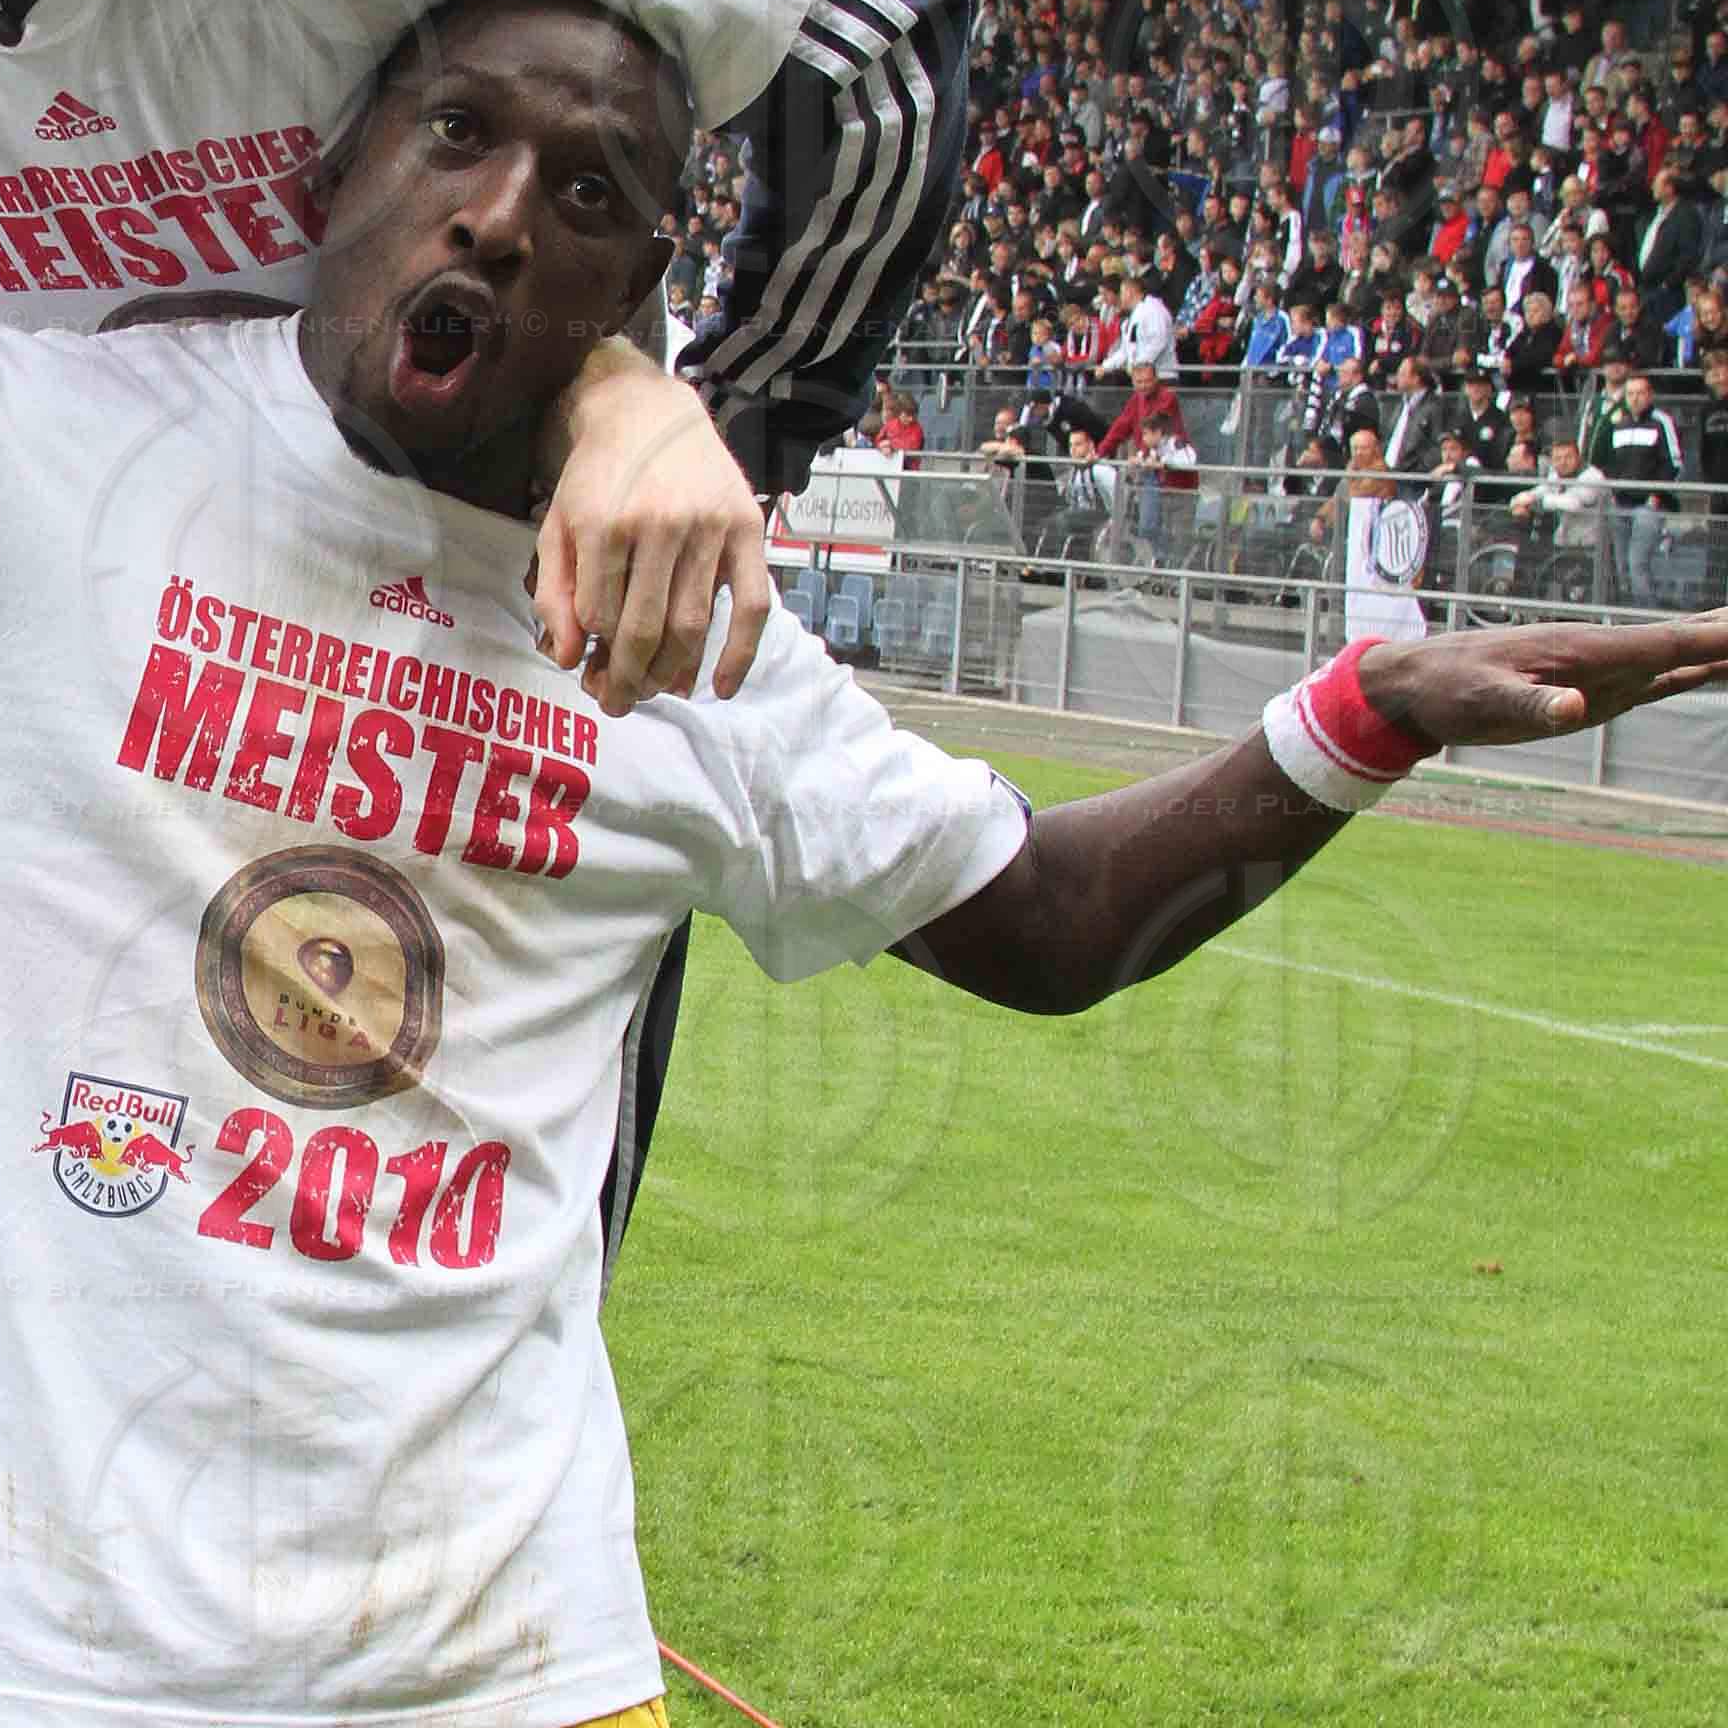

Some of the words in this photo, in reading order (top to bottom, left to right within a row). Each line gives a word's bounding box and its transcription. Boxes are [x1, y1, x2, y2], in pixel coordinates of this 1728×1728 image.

[35, 117, 116, 140] adidas
[370, 590, 455, 628] adidas
[157, 575, 599, 766] ÖSTERREICHISCHER
[116, 644, 594, 880] MEISTER
[274, 1008, 371, 1051] LIGA
[65, 1161, 152, 1208] SALZBURG
[197, 1107, 512, 1270] 2010
